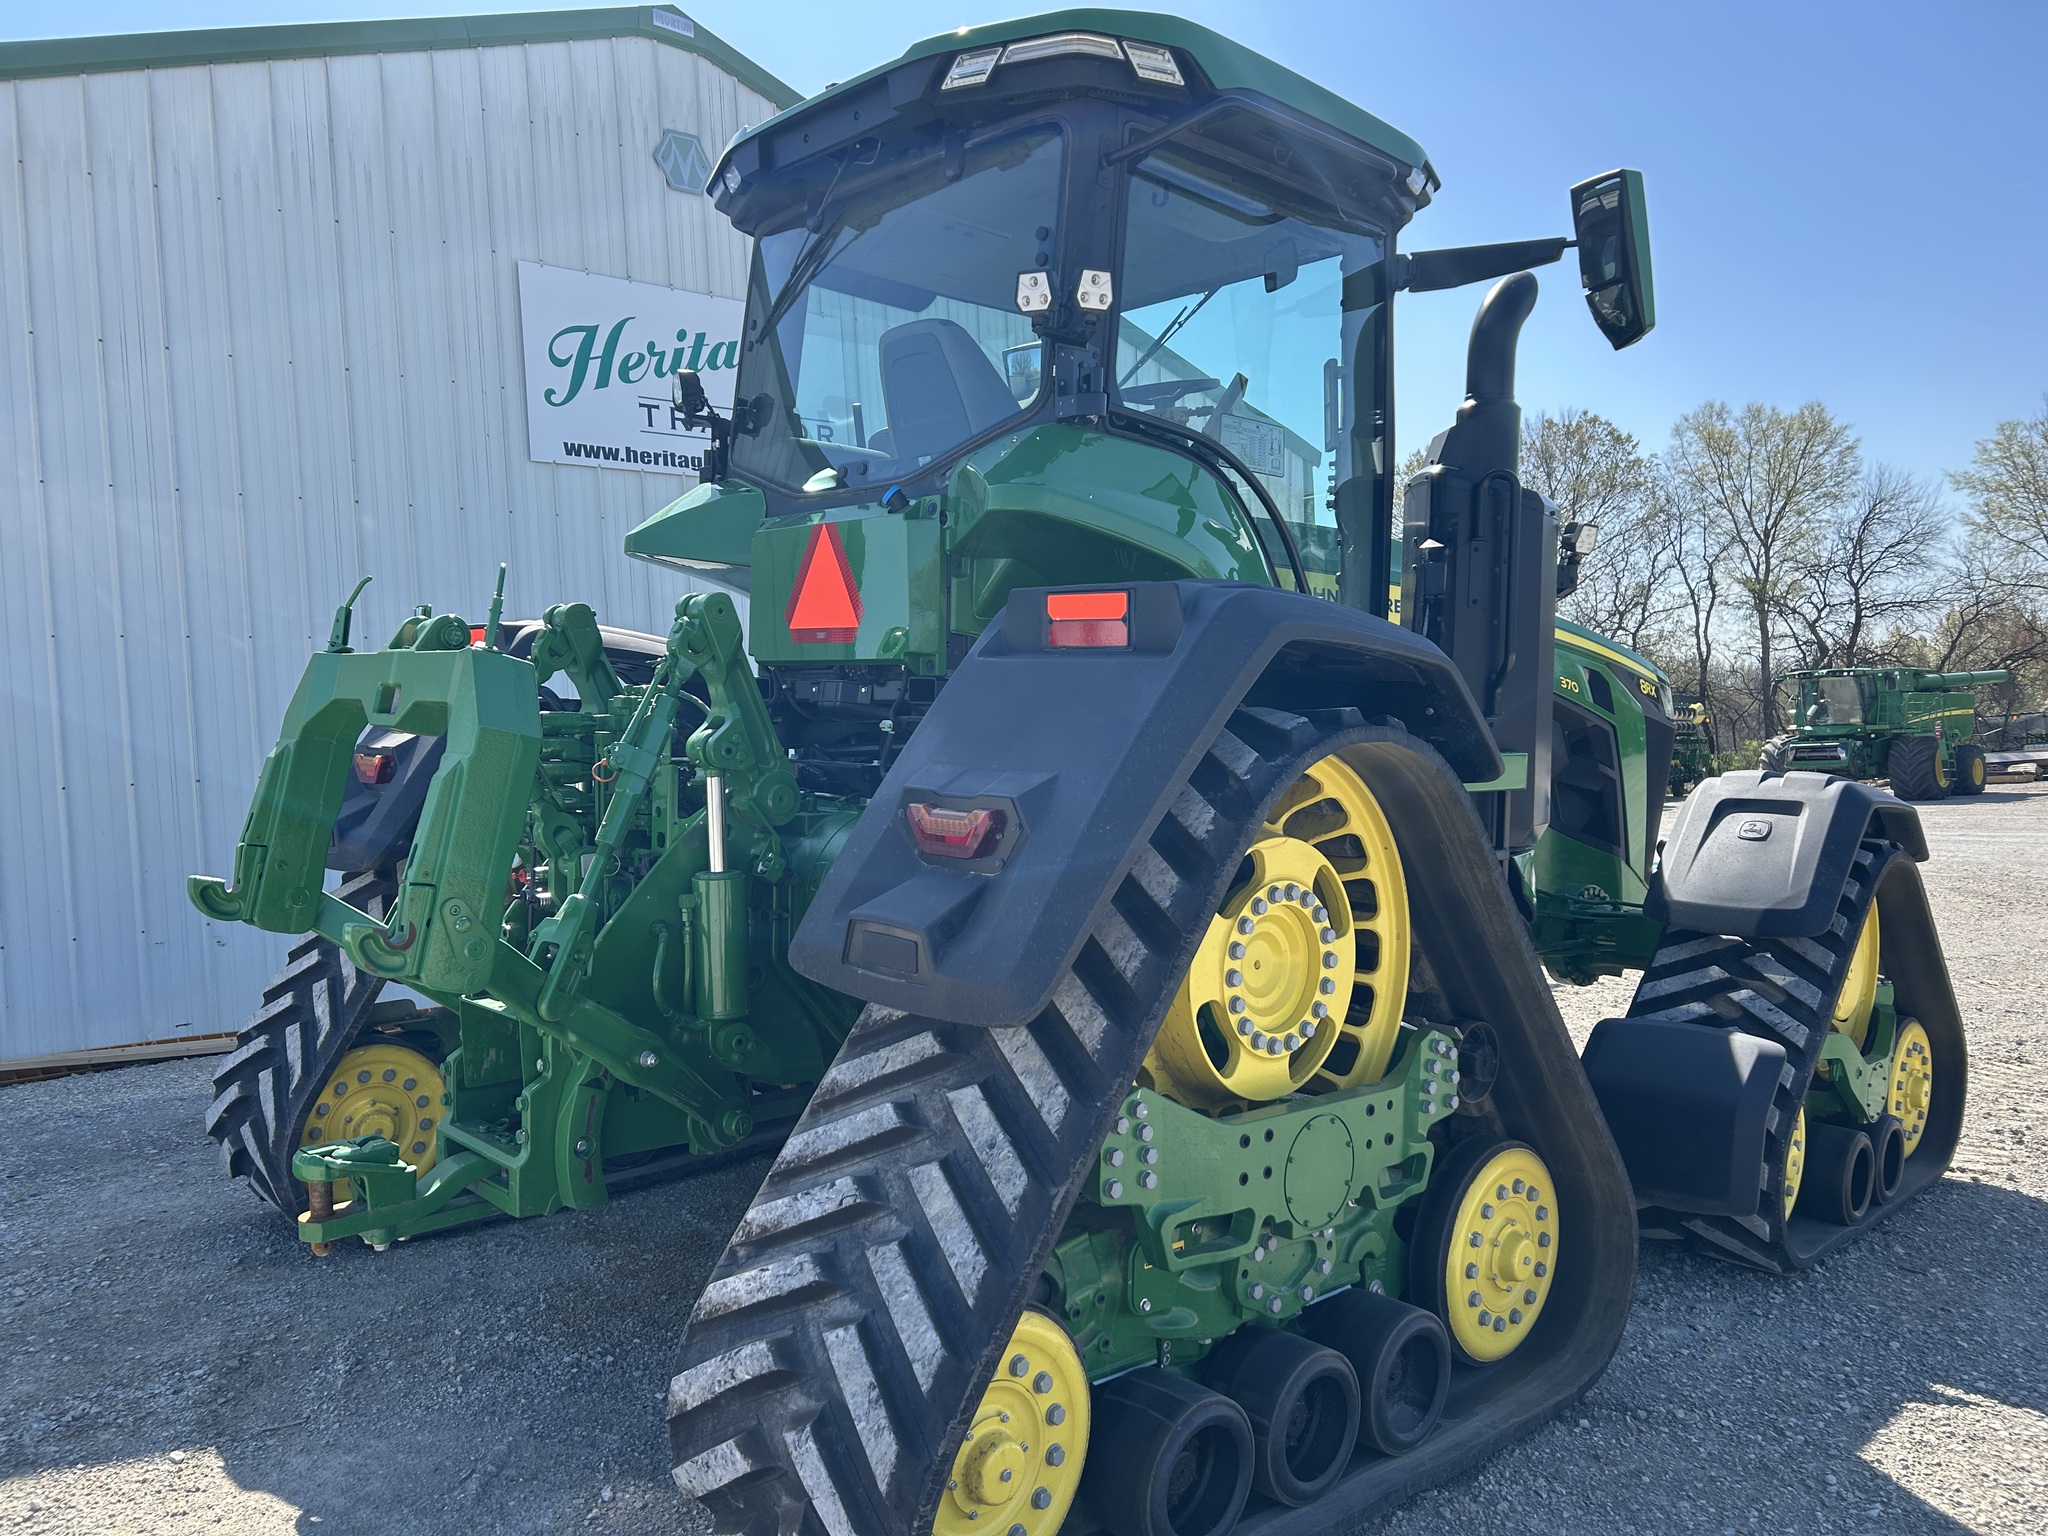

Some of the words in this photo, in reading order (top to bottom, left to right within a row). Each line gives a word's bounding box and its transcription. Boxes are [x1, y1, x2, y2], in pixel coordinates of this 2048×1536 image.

[544, 316, 740, 407] Herita
[563, 441, 703, 472] www.heritag
[1560, 676, 1580, 693] 370
[1640, 679, 1657, 698] 8RX
